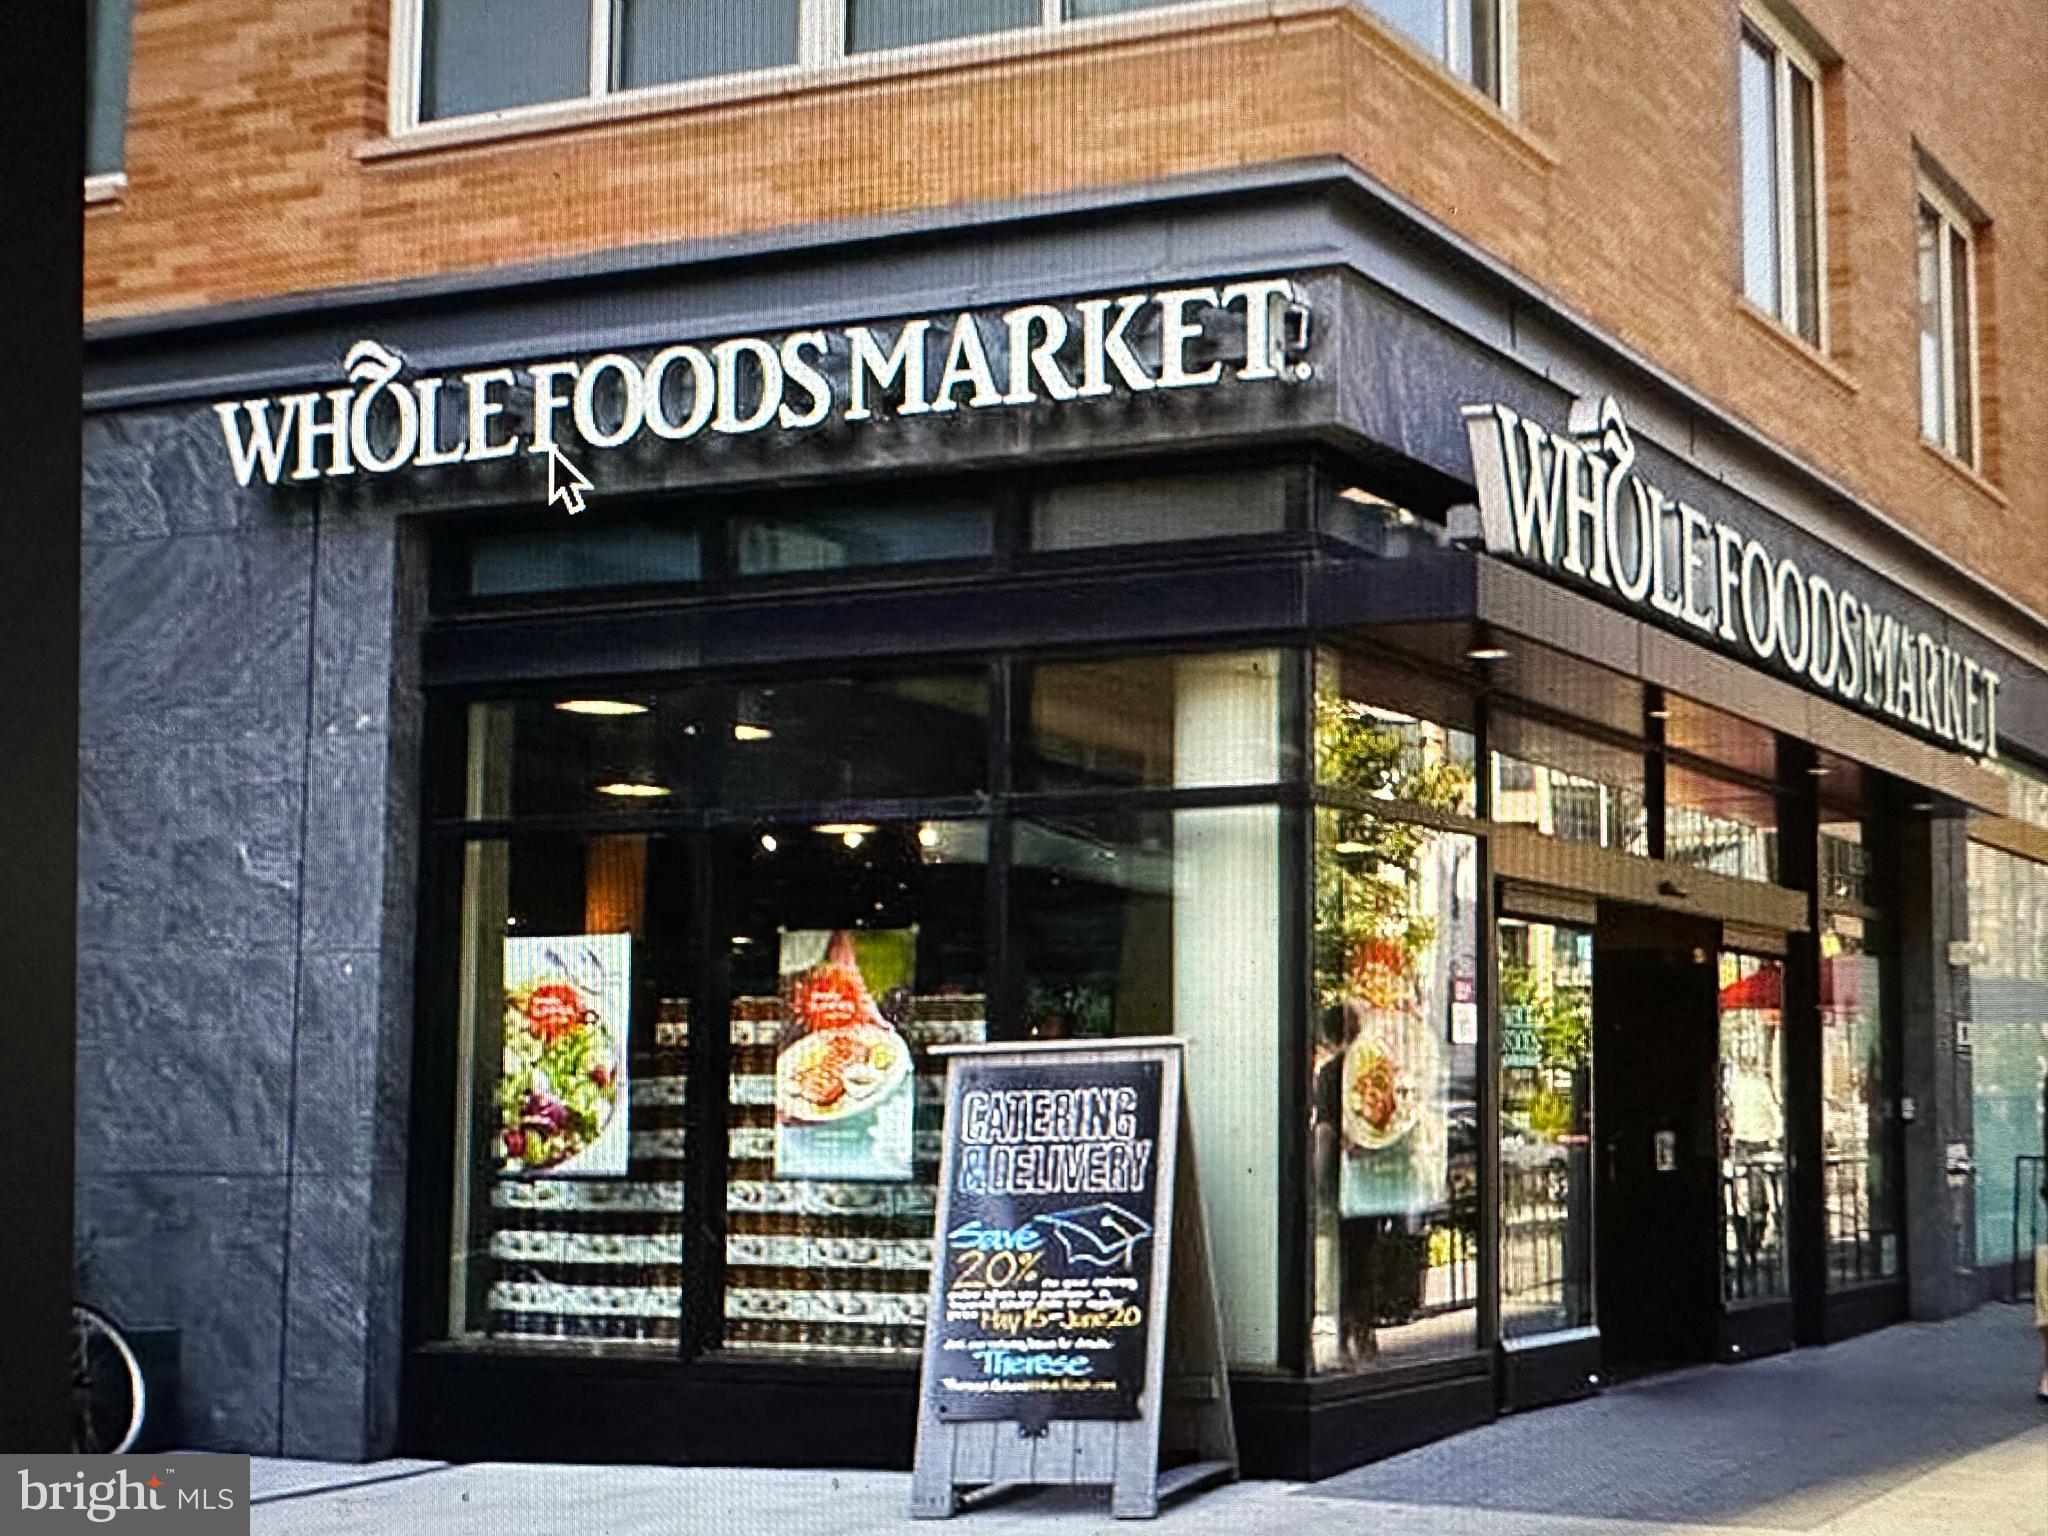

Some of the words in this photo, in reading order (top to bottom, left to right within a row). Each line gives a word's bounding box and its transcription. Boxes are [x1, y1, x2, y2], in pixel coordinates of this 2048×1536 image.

[214, 340, 518, 487] WHOLE
[528, 333, 831, 455] FOODS
[1493, 396, 1720, 631] WHOLE
[1716, 524, 1860, 700] FOODS
[1861, 601, 2000, 758] MARKET
[961, 1087, 1138, 1142] CATERING
[988, 1140, 1152, 1194] DELIVERY
[948, 1220, 1047, 1251] Save
[953, 1250, 1045, 1289] 20%
[972, 1351, 1094, 1377] Therese
